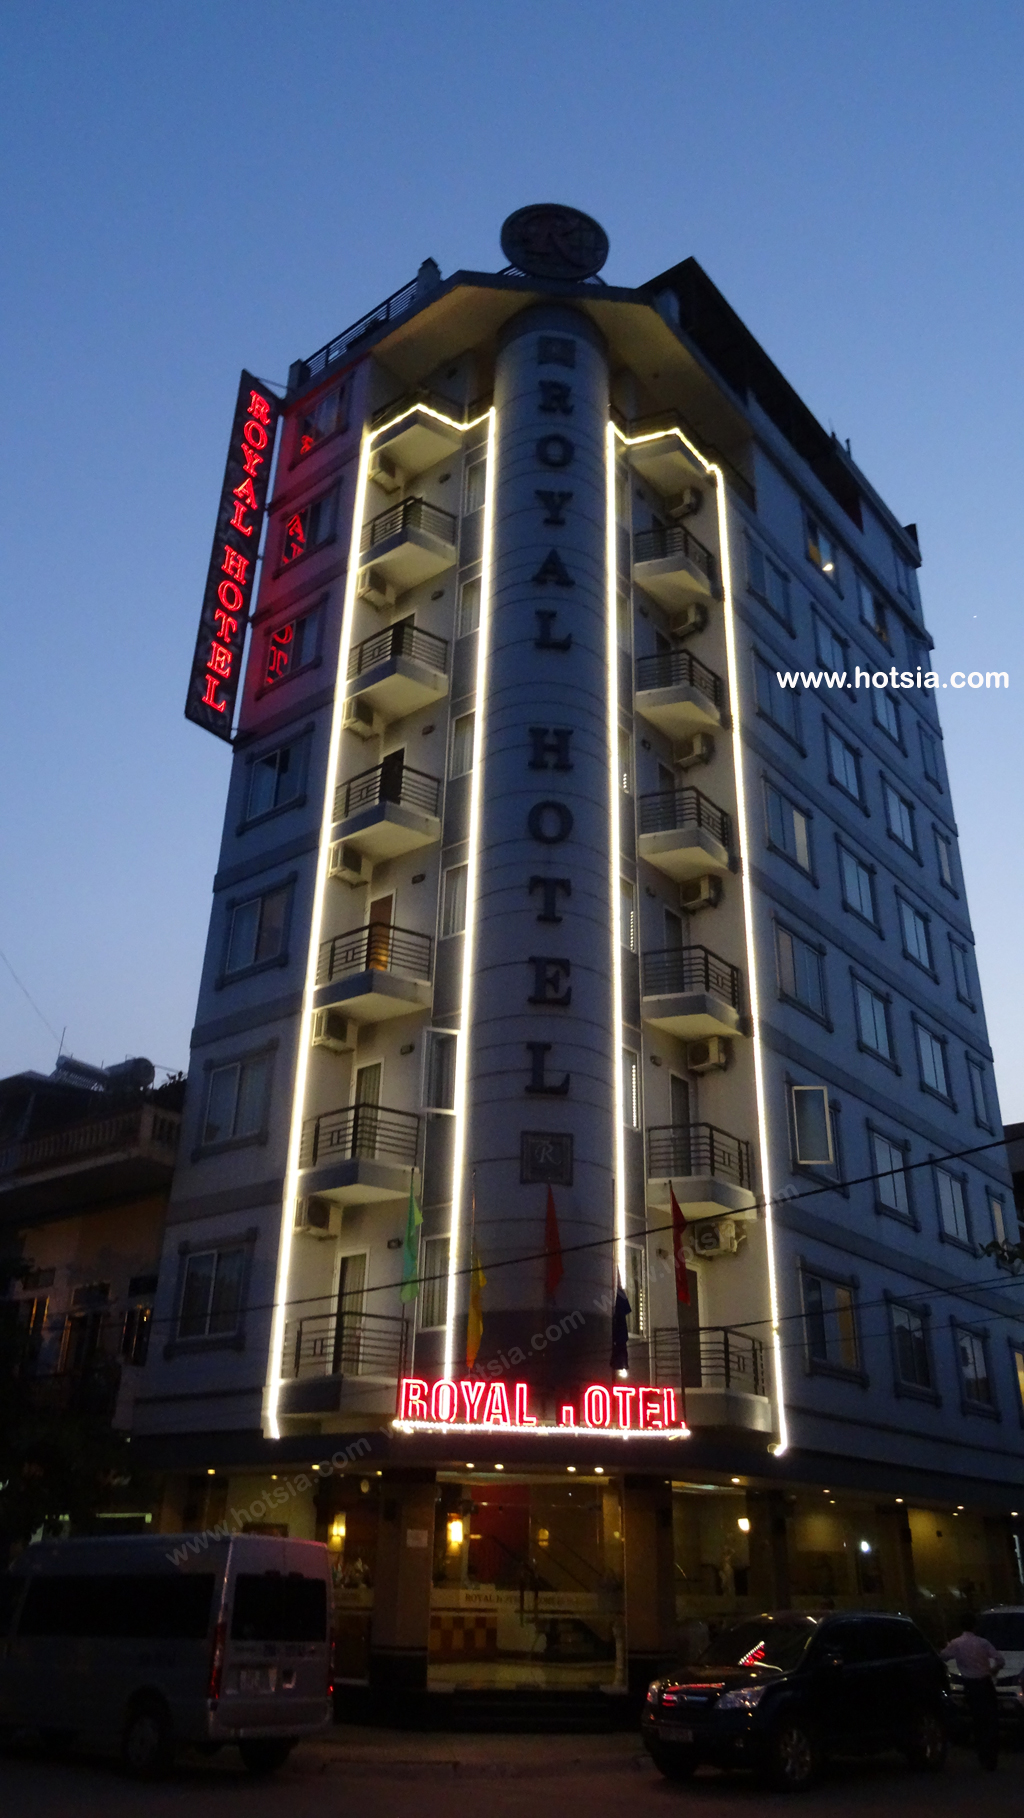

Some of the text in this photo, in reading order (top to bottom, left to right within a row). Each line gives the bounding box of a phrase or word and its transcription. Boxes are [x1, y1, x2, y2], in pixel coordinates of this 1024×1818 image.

[201, 389, 271, 713] ROYAL HOTEL
[524, 380, 575, 1096] ROYAL HOTEL
[400, 1377, 537, 1427] ROYAL
